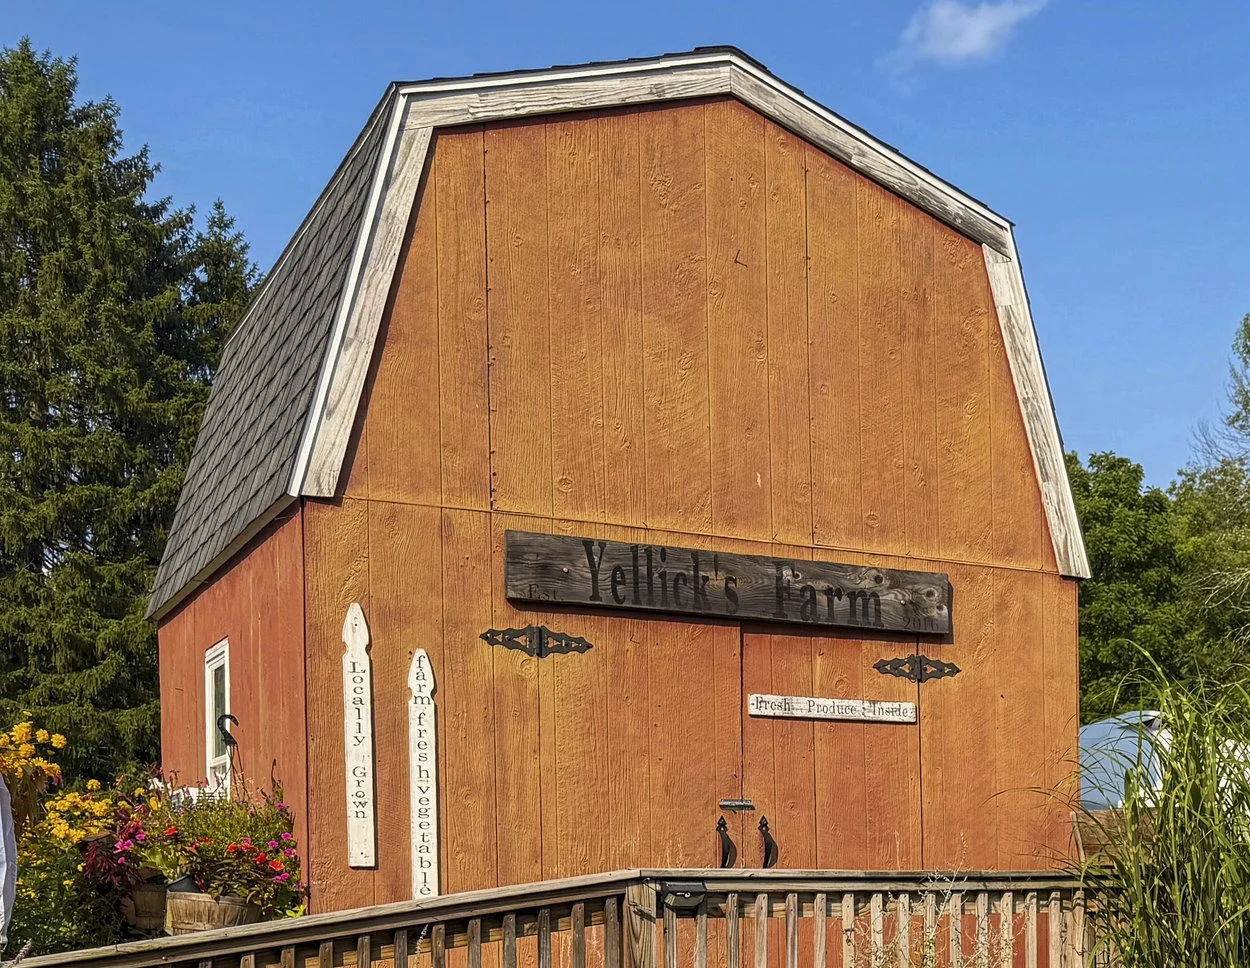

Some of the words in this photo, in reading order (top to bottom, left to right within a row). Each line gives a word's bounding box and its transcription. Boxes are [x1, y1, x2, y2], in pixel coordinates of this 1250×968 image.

[582, 540, 740, 615] Yellick's
[772, 561, 885, 628] Farm
[902, 617, 939, 631] 2016
[349, 661, 367, 747] Locally
[413, 655, 432, 705] farm
[755, 696, 791, 712] Fresh
[807, 700, 857, 715] Produce
[871, 702, 908, 717] Inside
[416, 711, 431, 780] fresh
[351, 766, 368, 819] Grown
[417, 786, 432, 896] vegetable
